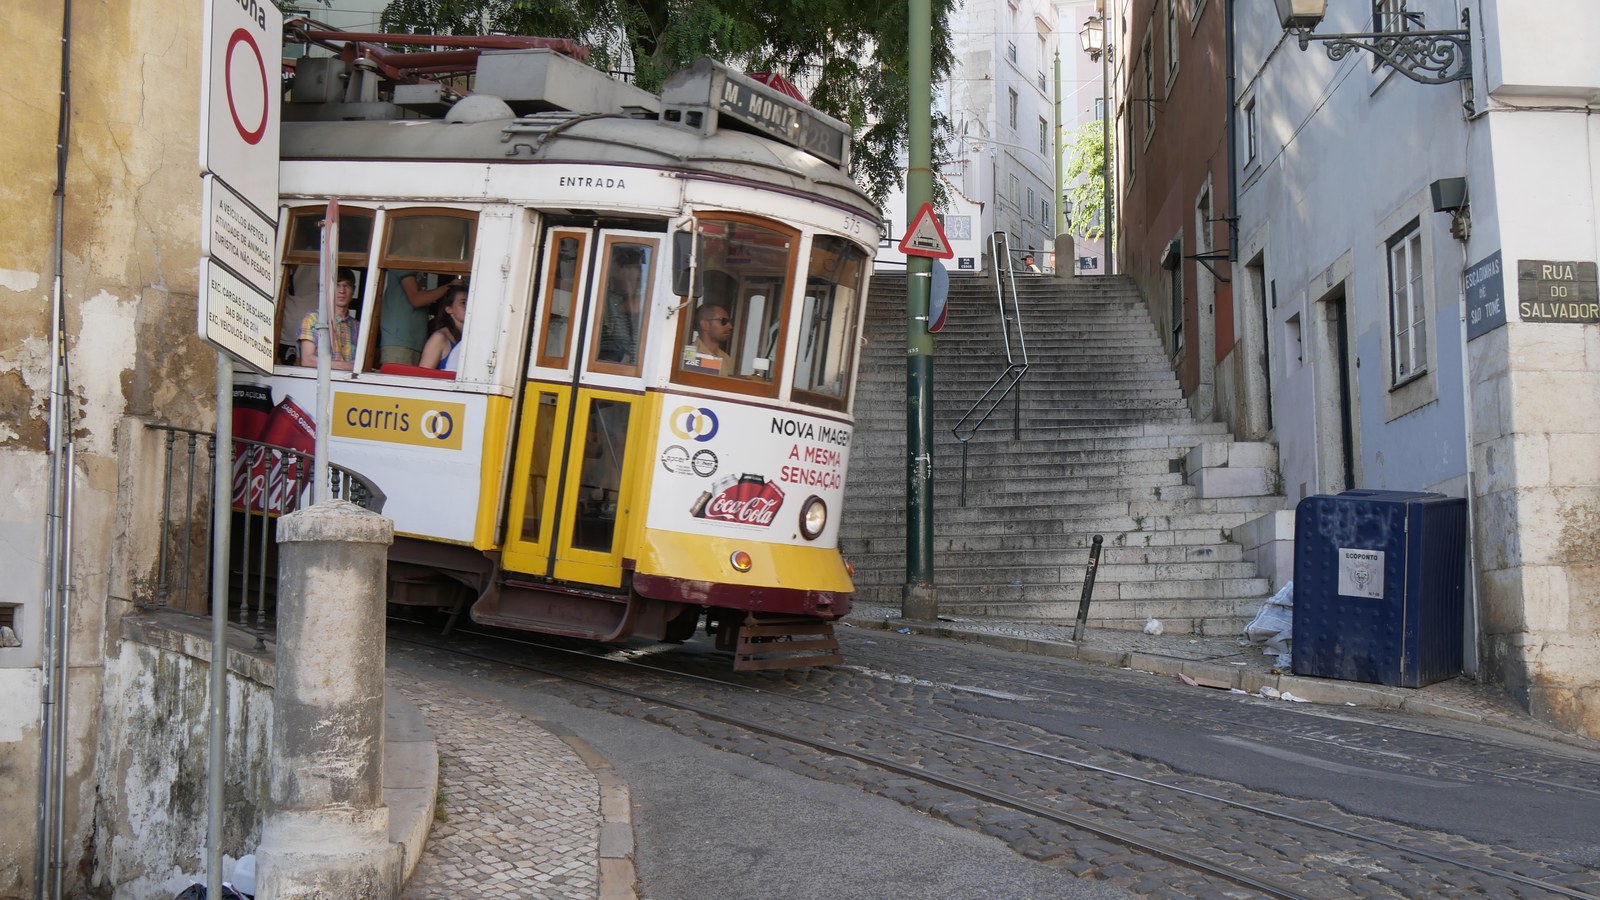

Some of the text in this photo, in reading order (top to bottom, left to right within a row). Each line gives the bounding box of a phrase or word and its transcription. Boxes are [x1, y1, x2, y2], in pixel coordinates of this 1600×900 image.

[235, 0, 266, 31] ona
[724, 81, 742, 107] M.
[559, 176, 625, 189] ENTRADA
[843, 216, 861, 234] 575
[241, 233, 247, 246] DE
[240, 250, 250, 265] NÃO
[251, 258, 271, 281] PESADOS
[1542, 264, 1574, 280] RUA
[1550, 286, 1568, 298] DO
[1520, 302, 1600, 319] SALVADOR
[281, 403, 299, 420] SABOR
[346, 404, 410, 432] carris
[770, 417, 814, 440] NOVA
[788, 443, 841, 468] A MESMA
[780, 465, 841, 491] SENSAÇÃO
[1345, 552, 1378, 561] ECOPONTO
